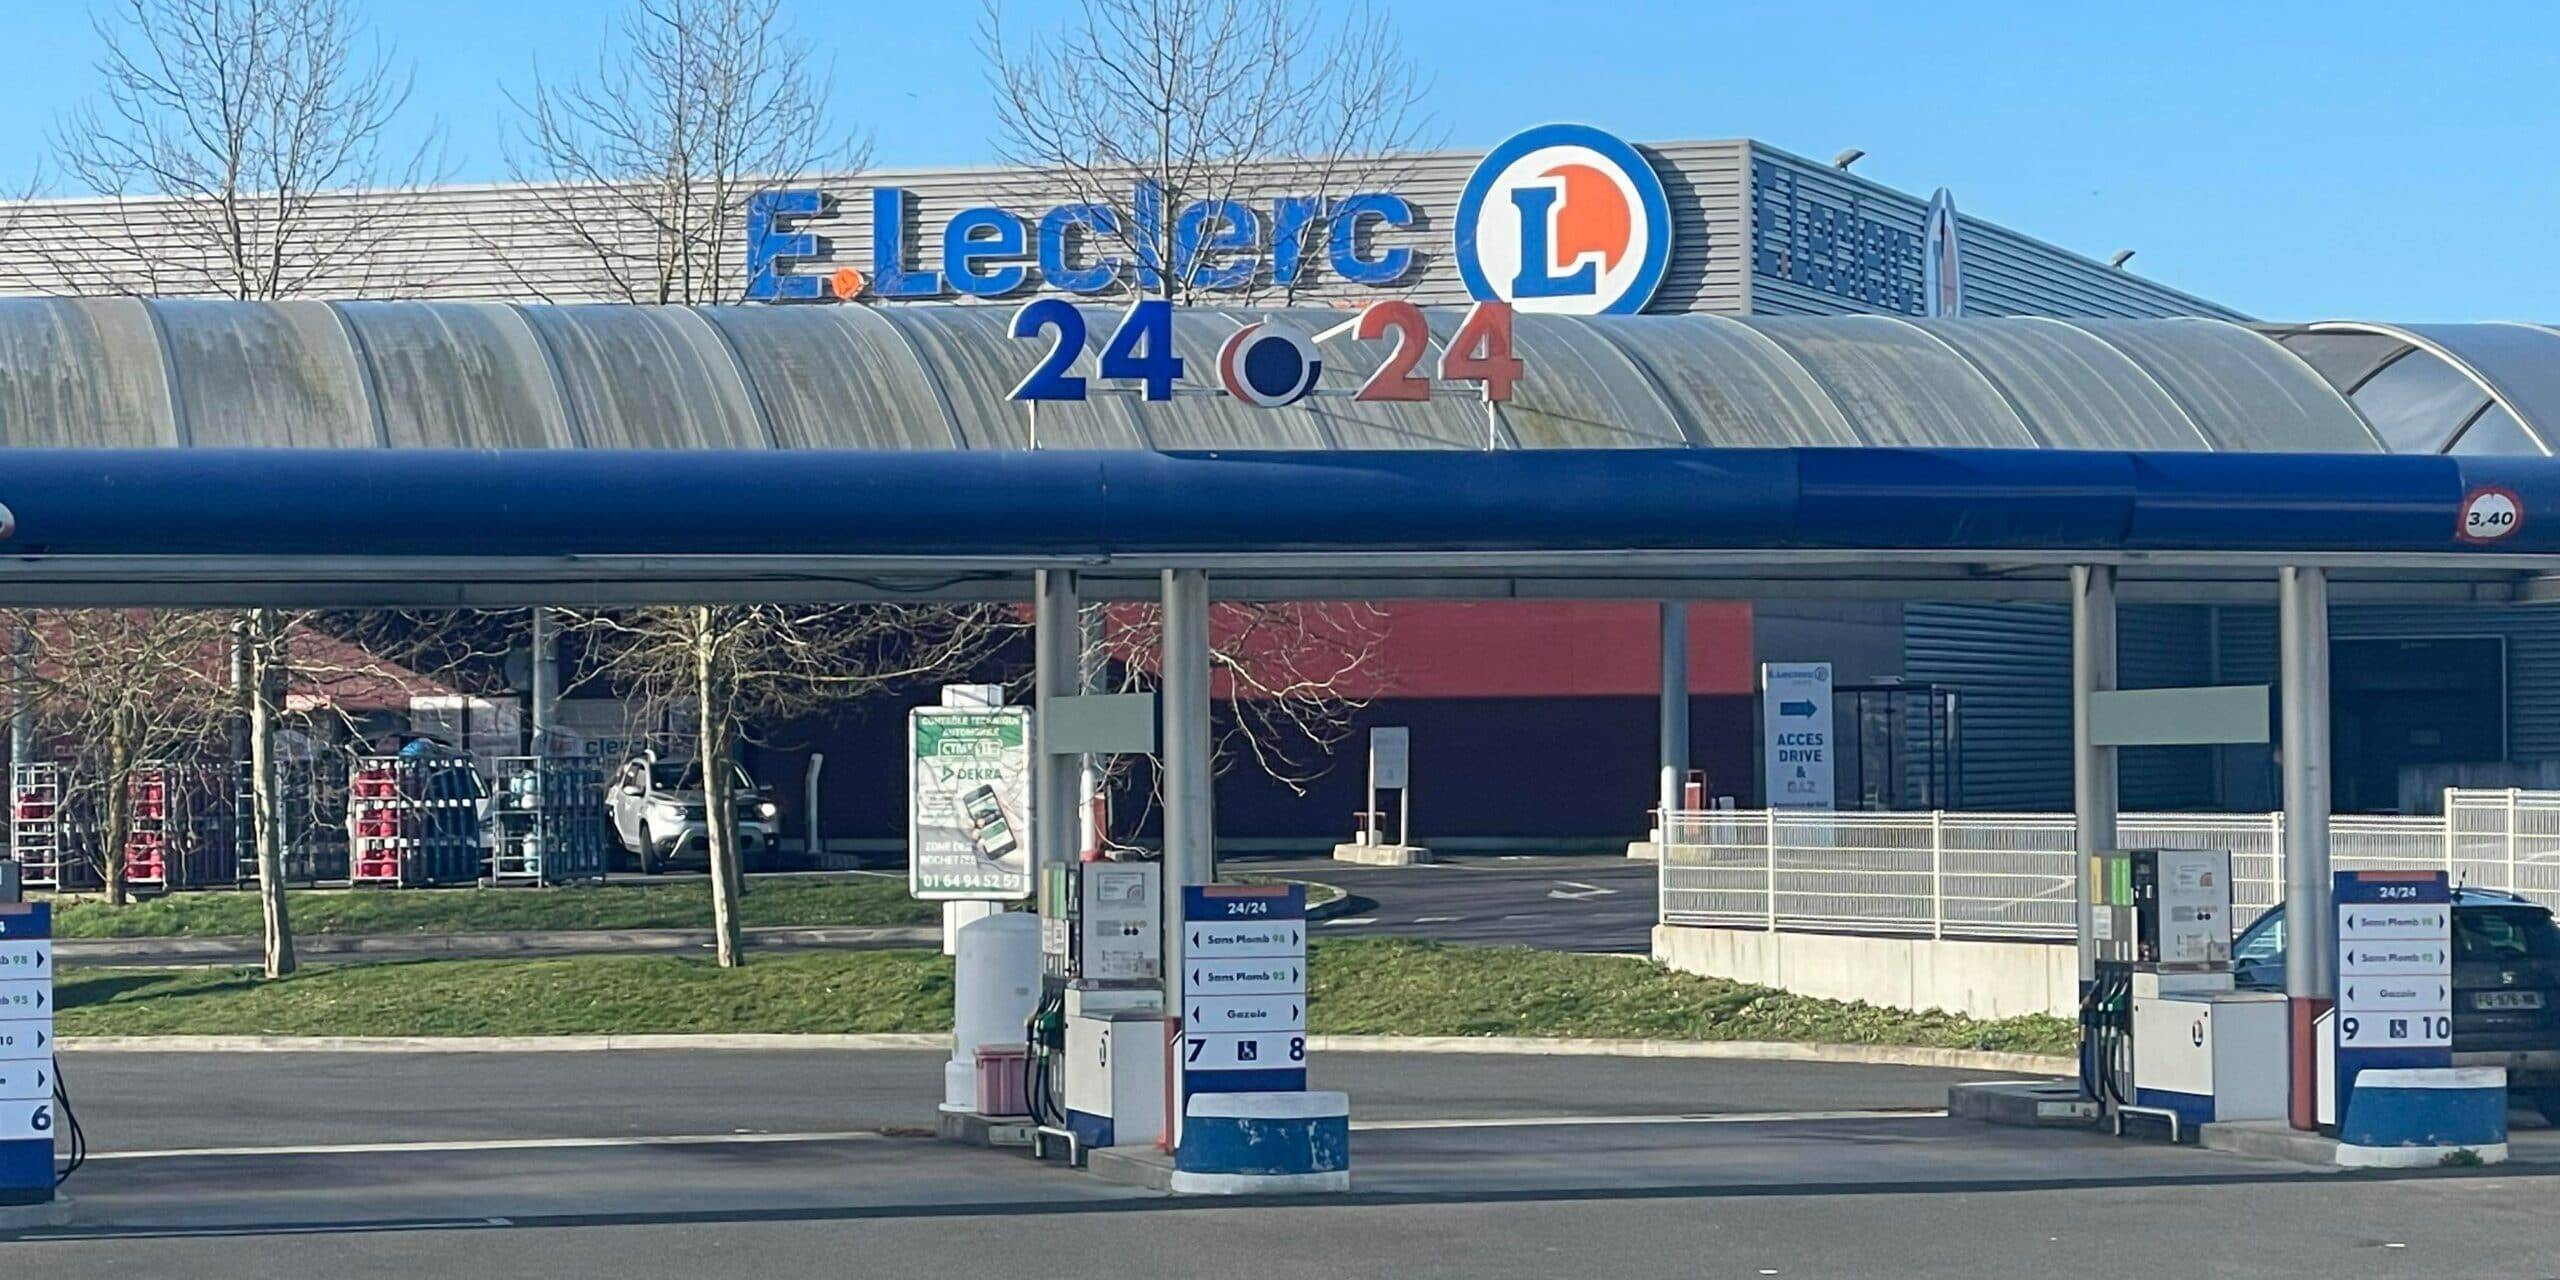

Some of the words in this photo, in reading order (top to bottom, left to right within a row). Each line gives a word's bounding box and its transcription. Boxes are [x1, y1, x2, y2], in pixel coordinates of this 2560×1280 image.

[747, 178, 1414, 300] E.Leclerc
[1005, 298, 1185, 402] 24
[1352, 300, 1524, 402] 24
[2468, 512, 2514, 527] 3,40
[1777, 733, 1823, 746] ACCES
[1779, 750, 1823, 762] DRIVE
[957, 767, 1002, 780] DEKRA
[1796, 766, 1806, 778] &
[923, 874, 940, 888] 01
[942, 874, 961, 888] 64
[962, 874, 981, 888] 94
[983, 874, 1001, 888] 52
[2380, 887, 2416, 898] 24/24
[1227, 902, 1267, 915] 24/24
[1207, 935, 1234, 945] Sans
[1236, 933, 1270, 943] Plomb
[1207, 972, 1234, 982] Sans
[1236, 970, 1270, 981] Plomb
[1272, 971, 1285, 980] 95
[1227, 1009, 1267, 1019] Gazole
[2343, 1017, 2360, 1041] 9
[2423, 1016, 2450, 1039] 10
[1188, 1039, 1207, 1063] 7
[1289, 1037, 1305, 1062] 8
[31, 1105, 51, 1131] 6
